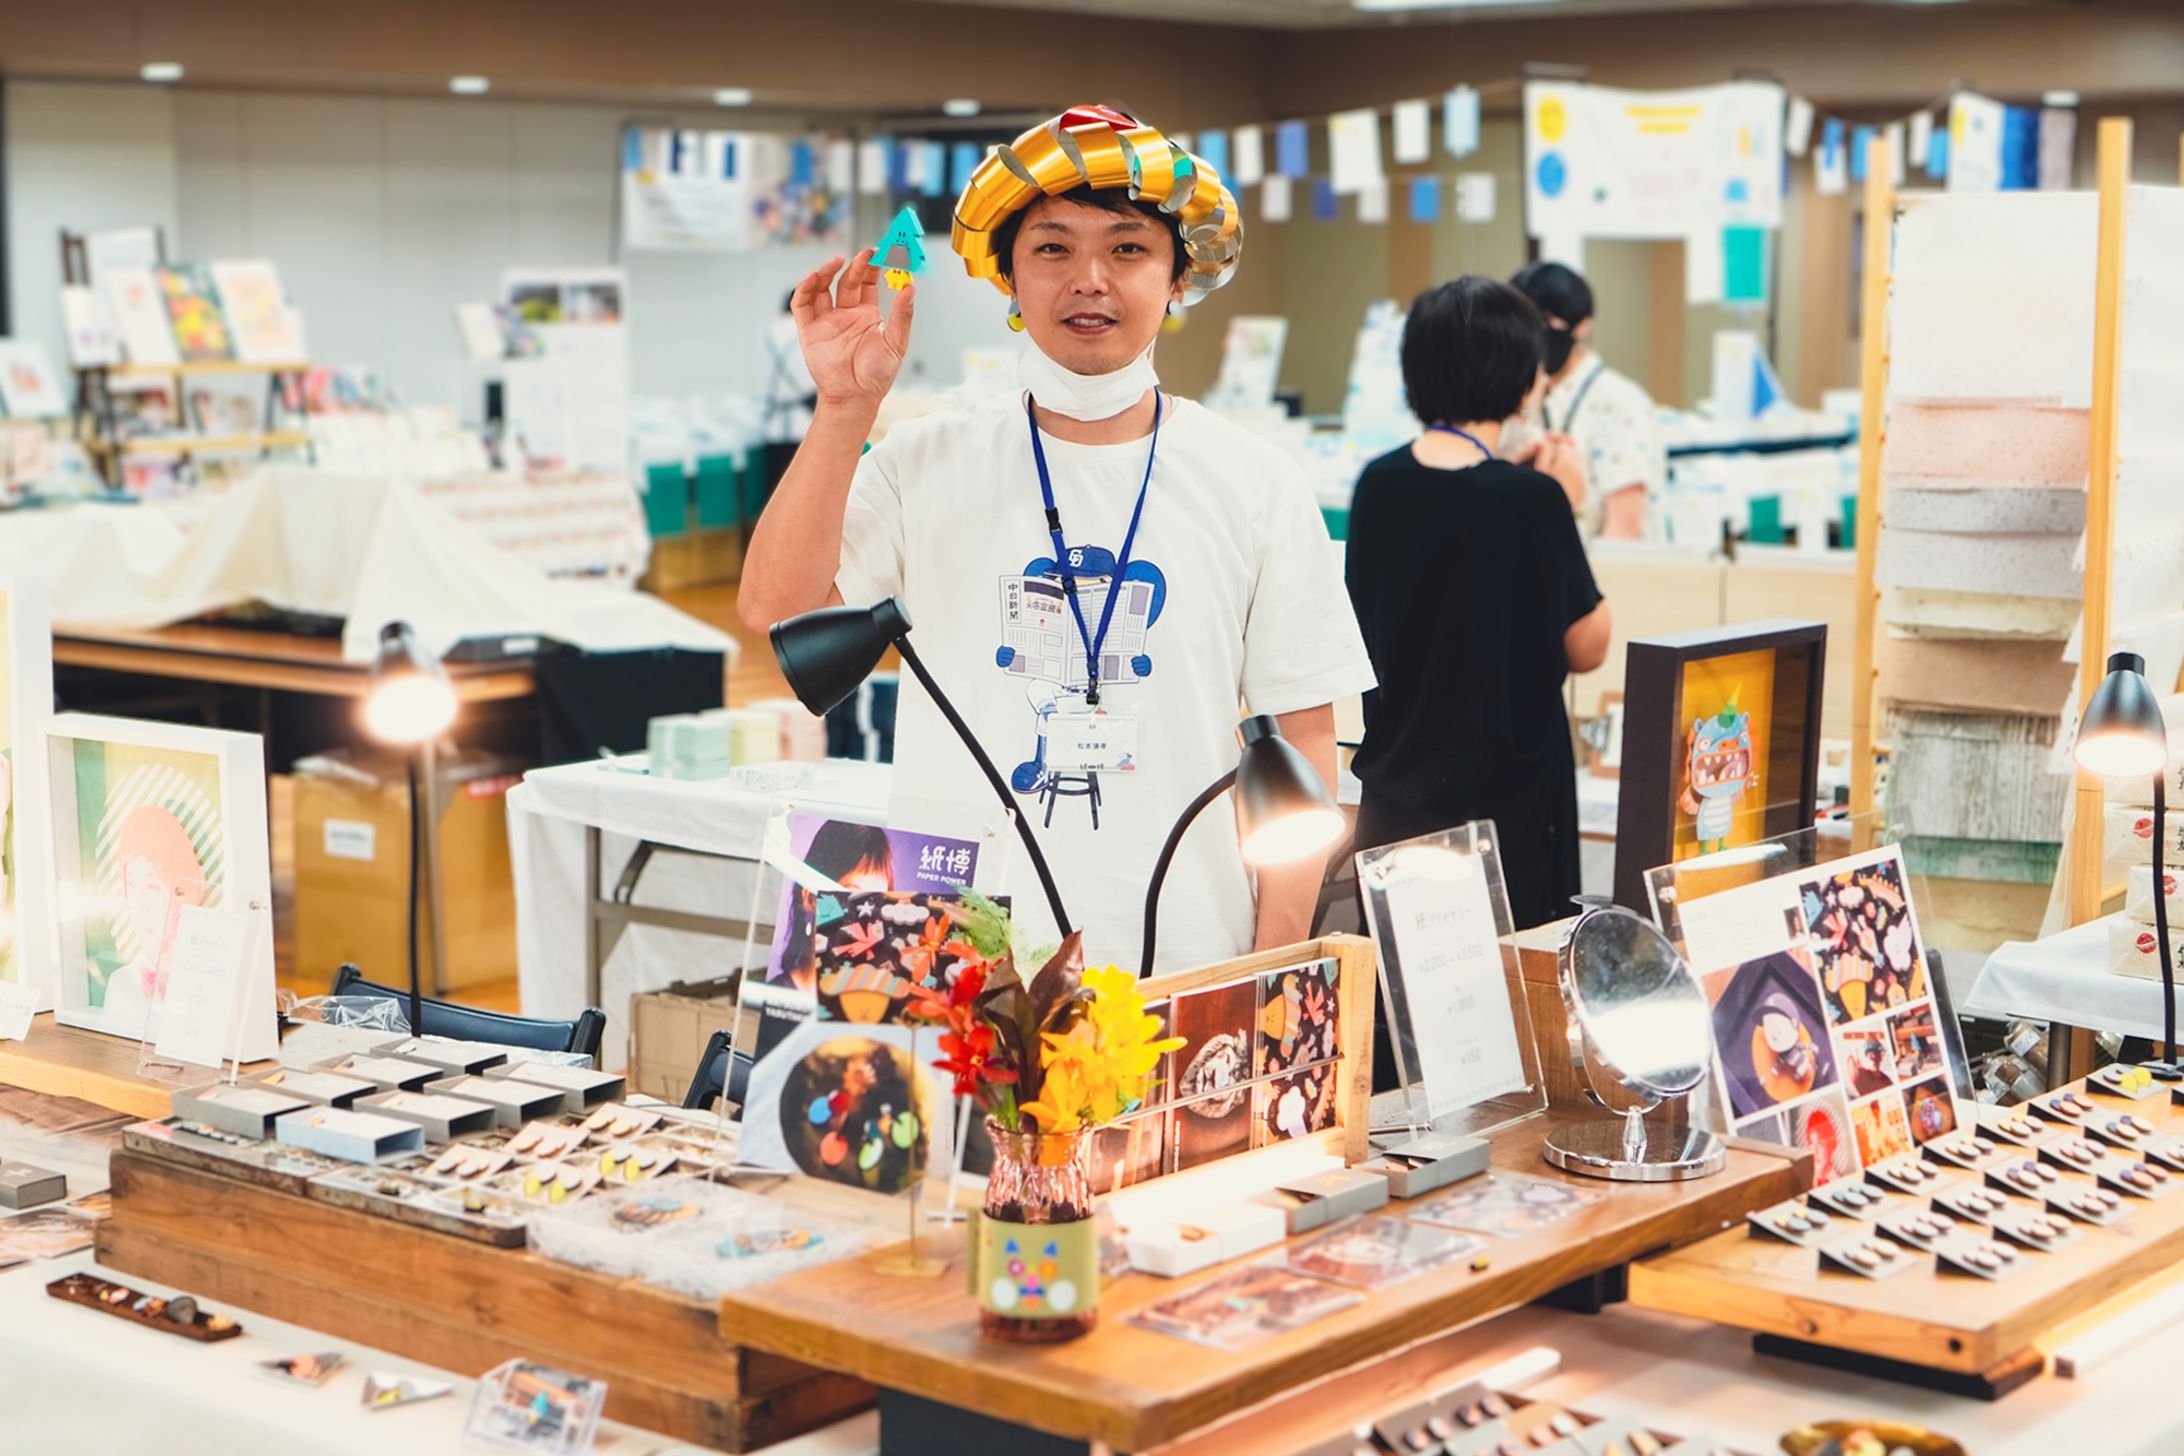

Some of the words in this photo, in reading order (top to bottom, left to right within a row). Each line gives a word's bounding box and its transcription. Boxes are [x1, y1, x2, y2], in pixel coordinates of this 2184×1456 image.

[1008, 583, 1018, 619] 中日新聞
[918, 845, 971, 875] 紙博
[916, 872, 940, 882] PAPER
[940, 875, 967, 886] POWER
